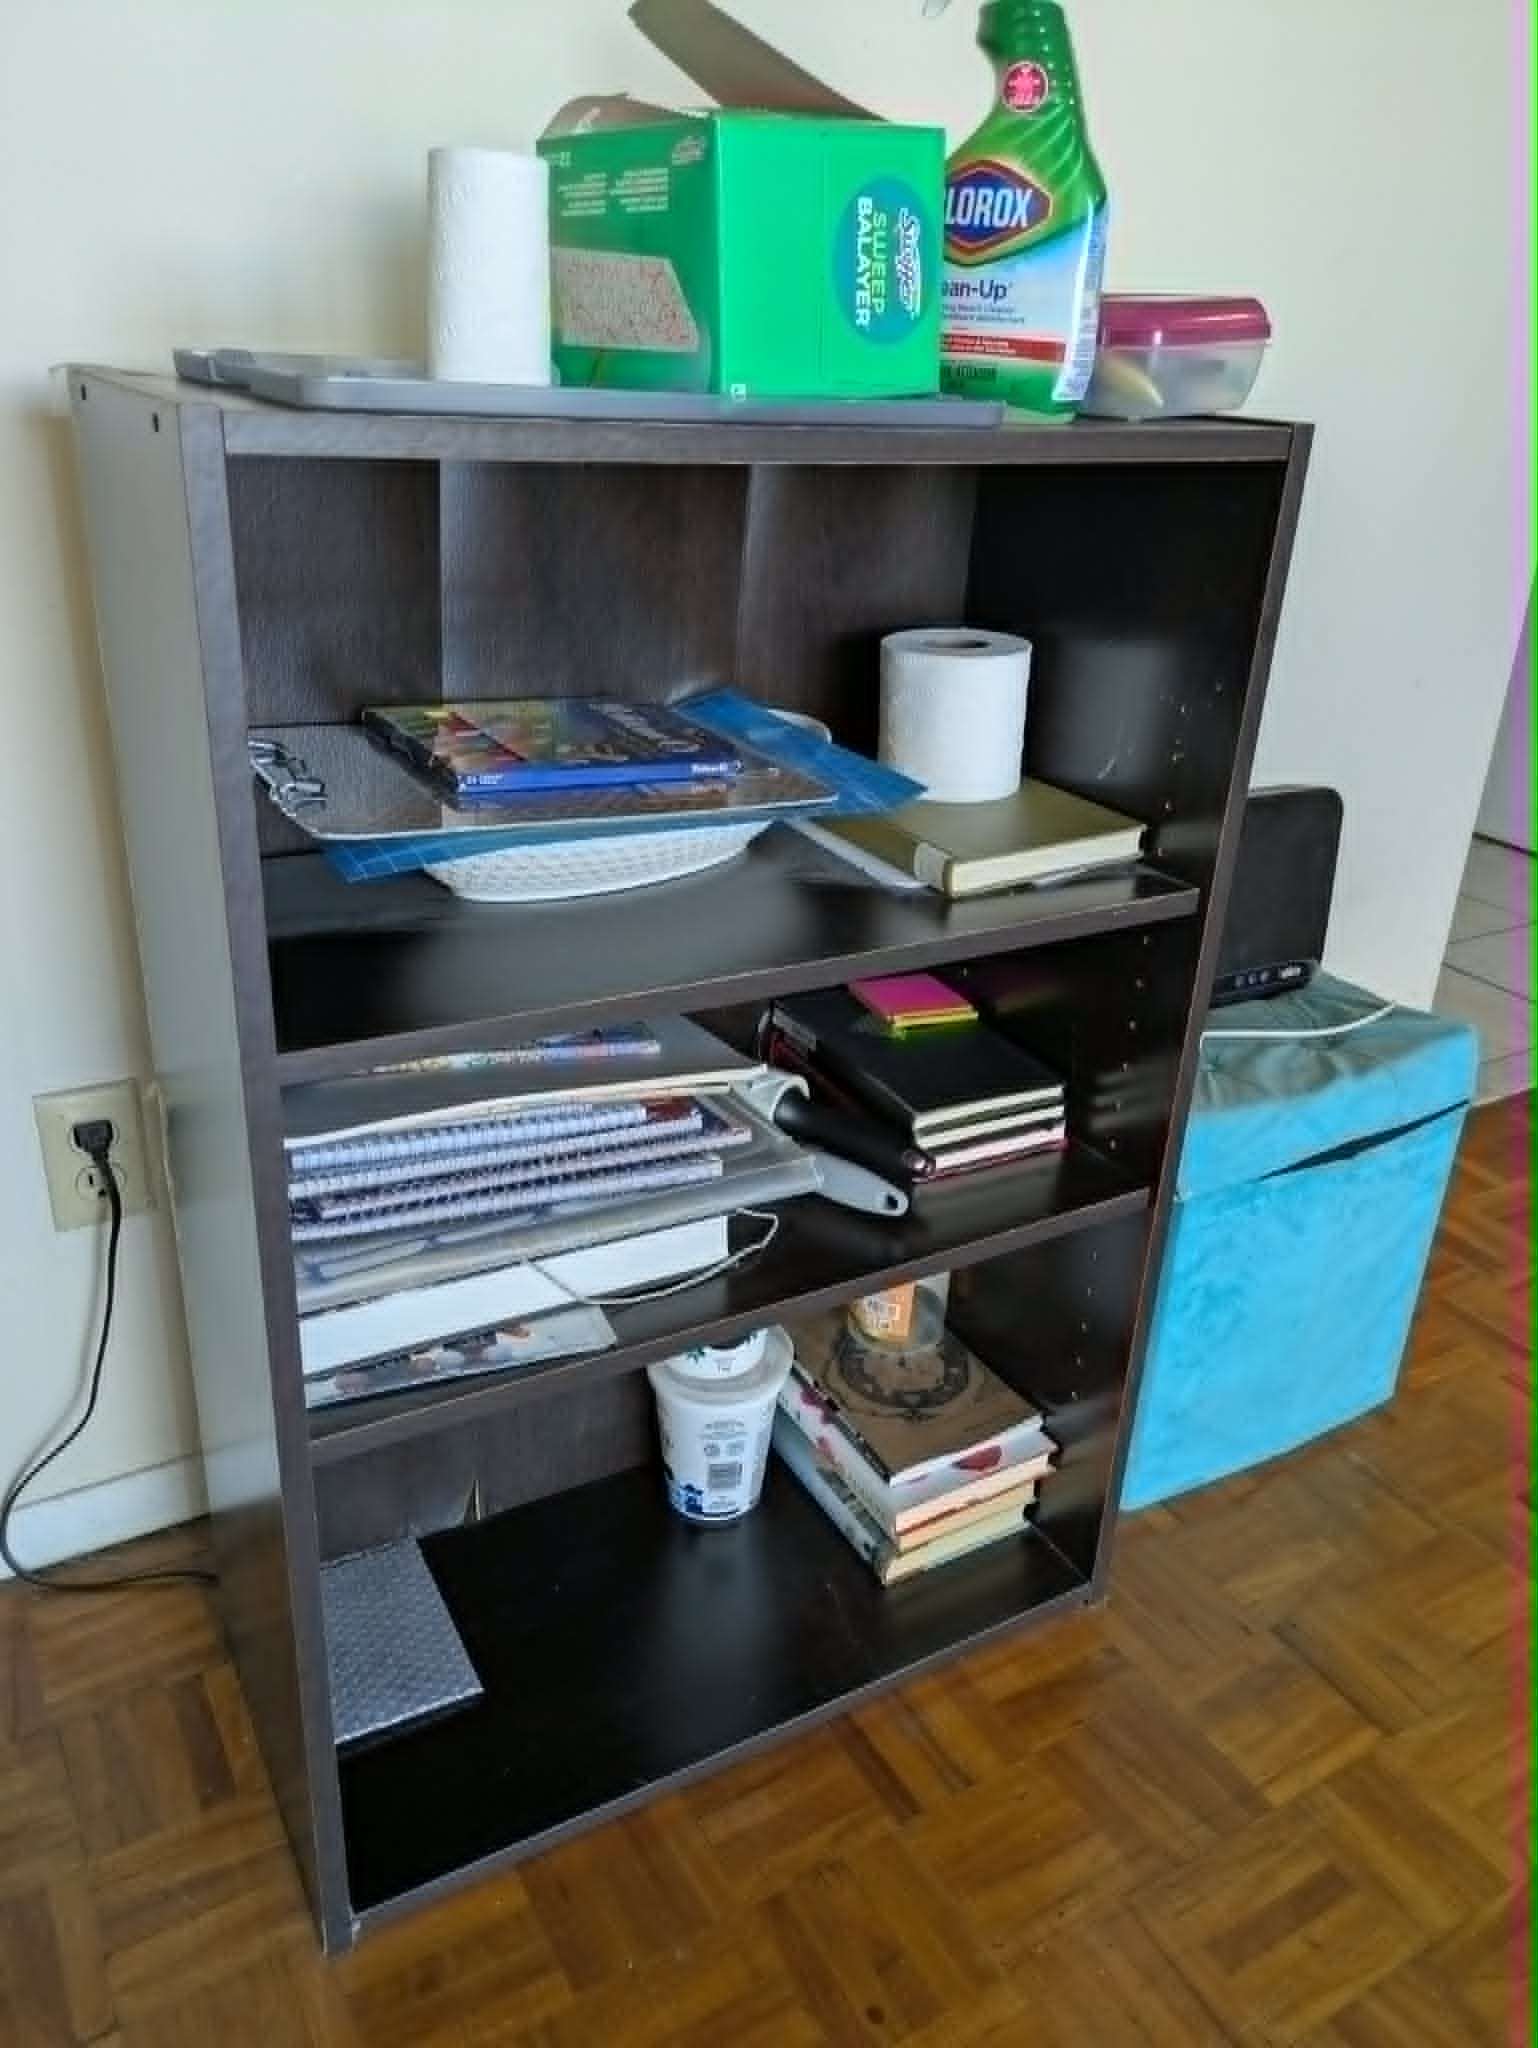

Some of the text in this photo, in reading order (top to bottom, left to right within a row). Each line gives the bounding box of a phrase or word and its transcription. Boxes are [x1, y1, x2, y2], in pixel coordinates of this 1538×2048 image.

[943, 186, 1032, 228] LOROX
[856, 196, 873, 328] BALAYER
[872, 211, 888, 315] SWEEP
